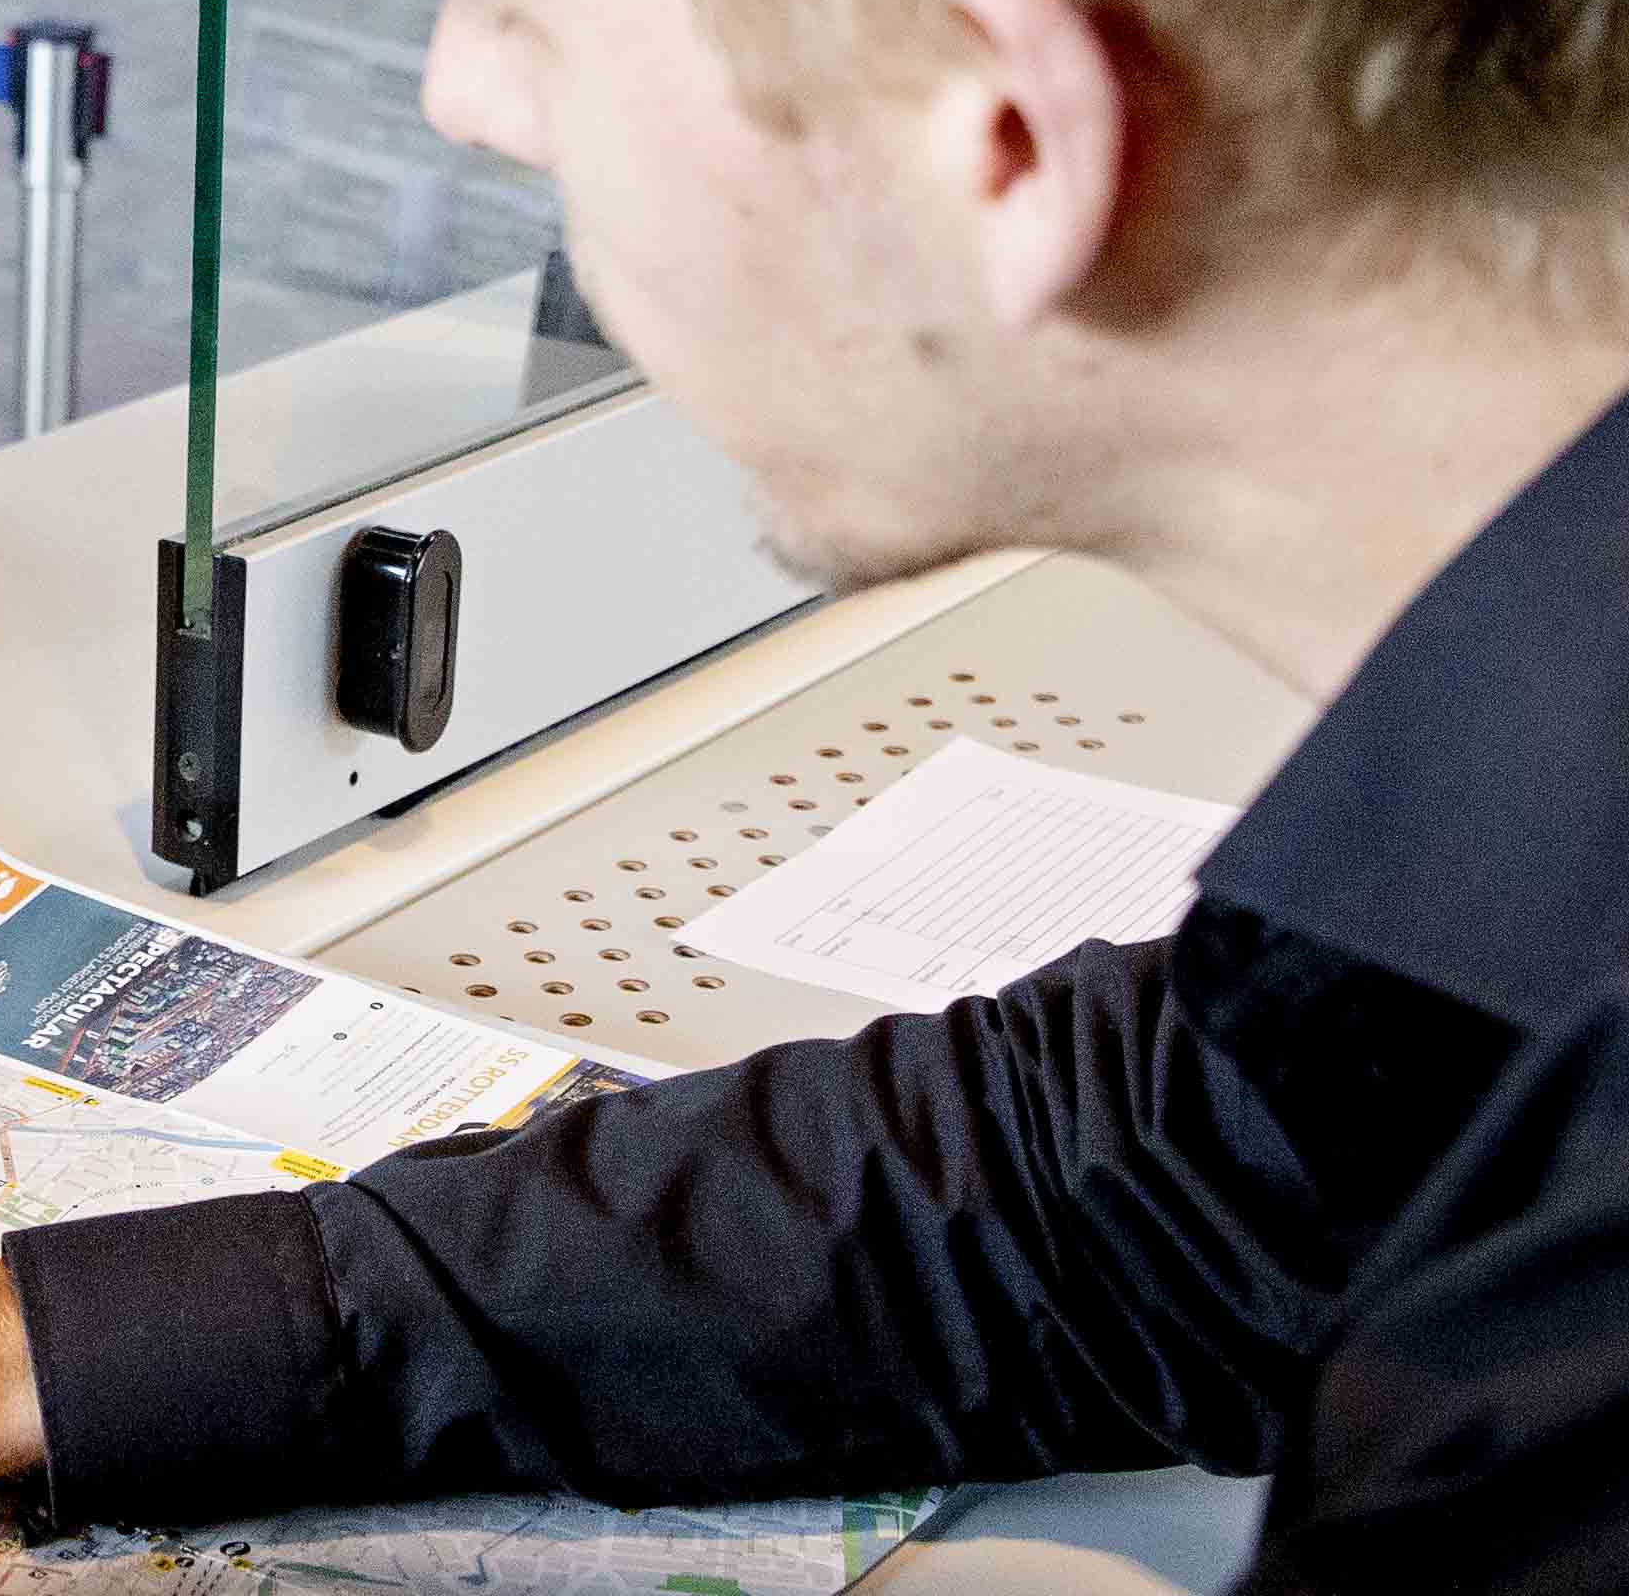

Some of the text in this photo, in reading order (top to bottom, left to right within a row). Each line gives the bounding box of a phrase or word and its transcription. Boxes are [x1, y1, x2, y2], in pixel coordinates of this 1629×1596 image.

[22, 926, 183, 1049] SPECTACULAR
[52, 956, 103, 995] LARGEST
[75, 963, 115, 992] CRUISE
[28, 989, 60, 1015] PORT
[28, 989, 81, 1029] THROUGH
[498, 1047, 531, 1068] SS
